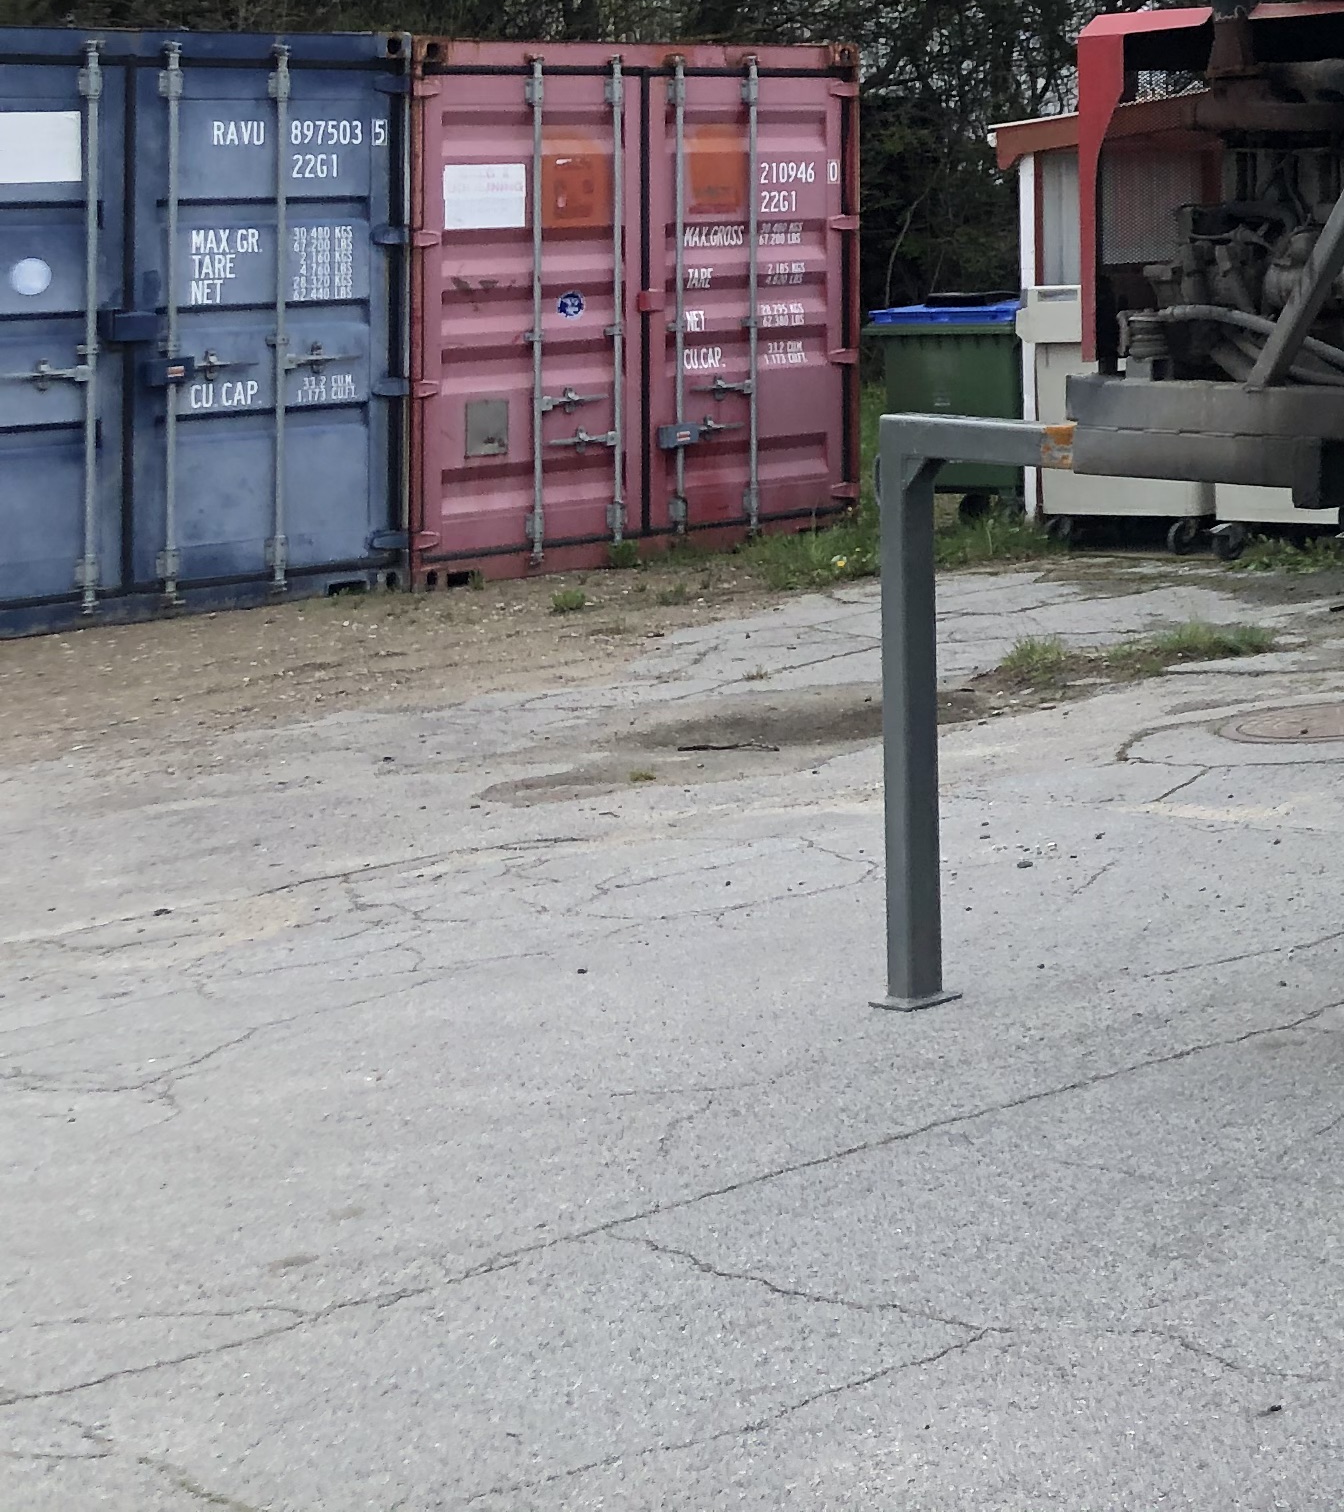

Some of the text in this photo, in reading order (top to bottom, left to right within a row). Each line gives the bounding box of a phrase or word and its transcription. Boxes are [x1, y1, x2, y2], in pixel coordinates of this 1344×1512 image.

[212, 119, 386, 146] RAVU 897503 5
[291, 153, 338, 178] 22G1
[760, 160, 839, 184] 210946 0
[760, 190, 797, 213] 22G1
[334, 225, 353, 239] KGS
[334, 238, 353, 251] LBS
[191, 253, 236, 279] TARE
[334, 250, 353, 263] KGS
[334, 262, 353, 275] LBS
[686, 267, 714, 289] TARE
[334, 274, 353, 287] KGS
[190, 279, 223, 305] NET
[334, 286, 353, 299] LBS
[685, 310, 706, 332] NET
